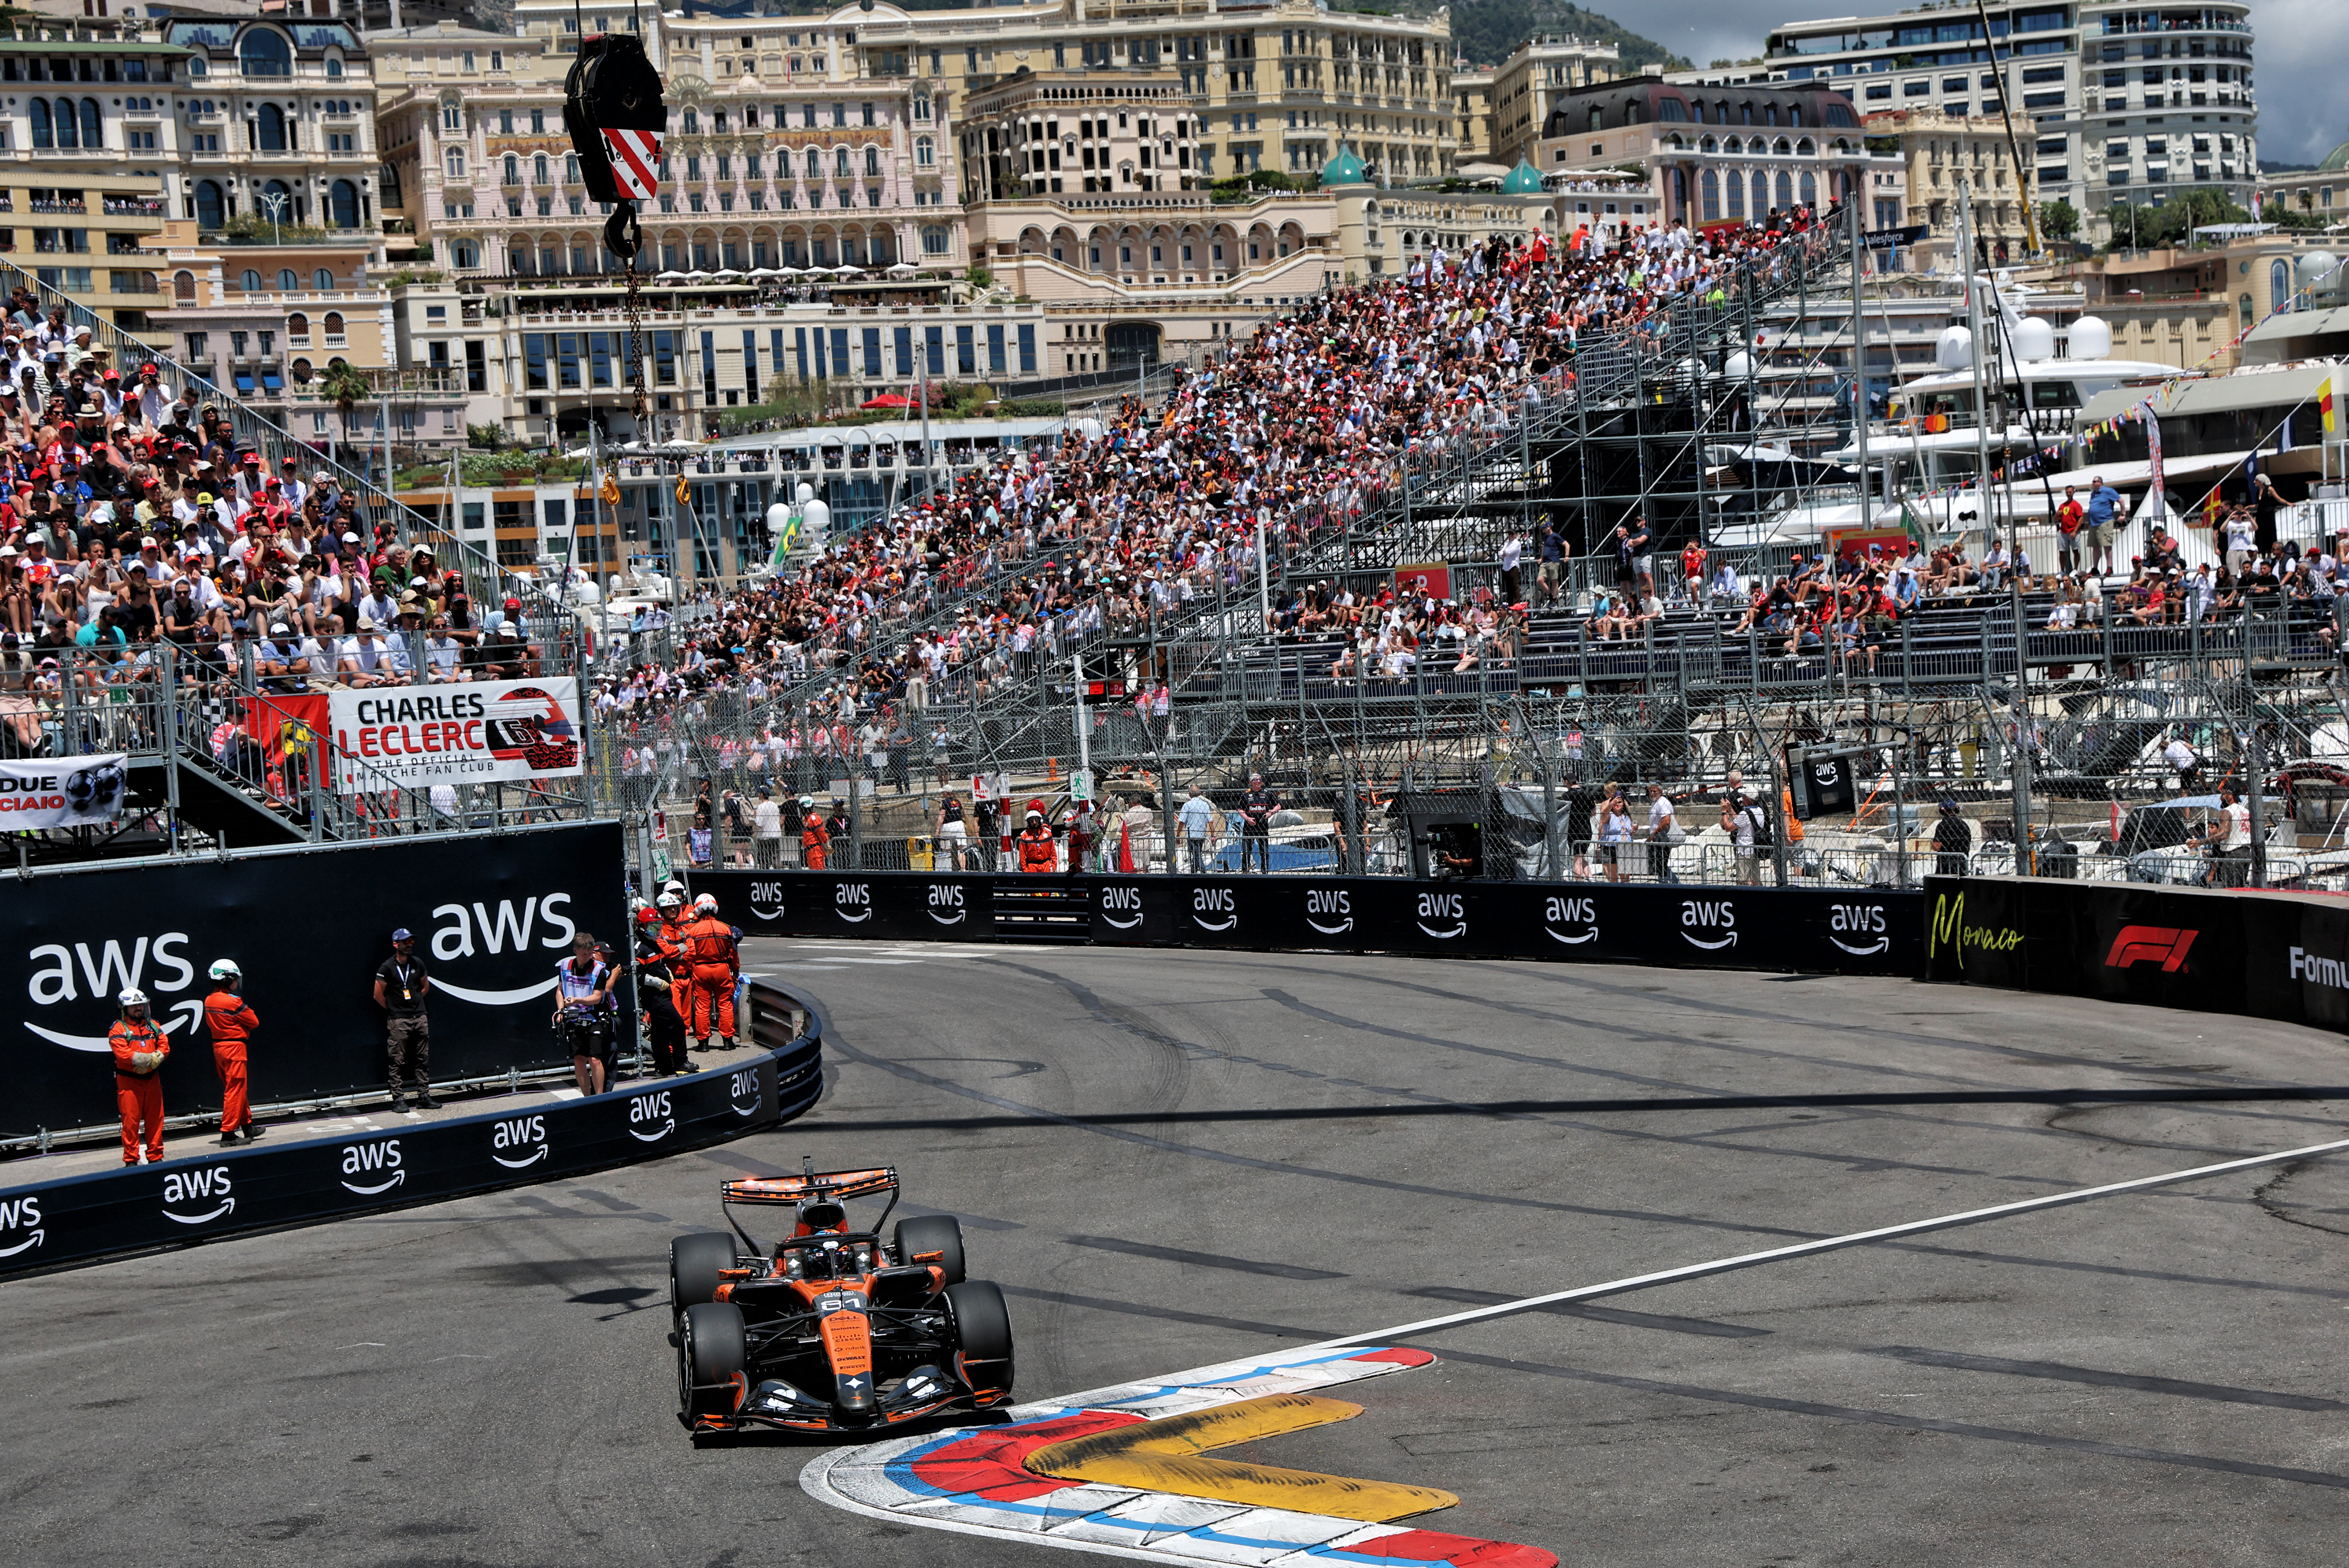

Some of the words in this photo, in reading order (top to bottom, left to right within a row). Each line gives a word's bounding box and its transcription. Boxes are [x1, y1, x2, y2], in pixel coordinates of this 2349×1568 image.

[358, 693, 484, 724] CHARLES
[338, 720, 484, 758] LECLERC
[357, 767, 418, 781] MARCHE
[426, 765, 452, 775] FAN
[460, 762, 494, 772] CLUB
[375, 758, 402, 769] THE
[411, 754, 476, 766] OFFICIAL
[1816, 762, 1836, 776] aws
[0, 776, 58, 792] DUE
[0, 796, 64, 811] CIAIO
[751, 883, 781, 902] aws
[837, 884, 869, 904] aws
[929, 885, 963, 907] aws
[1103, 888, 1141, 909] aws
[1194, 888, 1235, 911] aws
[1307, 890, 1350, 914] aws
[1418, 893, 1463, 918] aws
[1547, 897, 1595, 922] aws
[1683, 901, 1734, 927] aws
[432, 893, 575, 960] aws
[1832, 905, 1886, 932] aws
[1930, 891, 2024, 969] Monaco
[29, 932, 194, 1006] aws
[2290, 946, 2349, 989] Formu
[732, 1069, 759, 1098] aws
[631, 1091, 671, 1123] aws
[494, 1116, 545, 1148] aws
[343, 1140, 401, 1174] aws
[164, 1167, 231, 1202] aws
